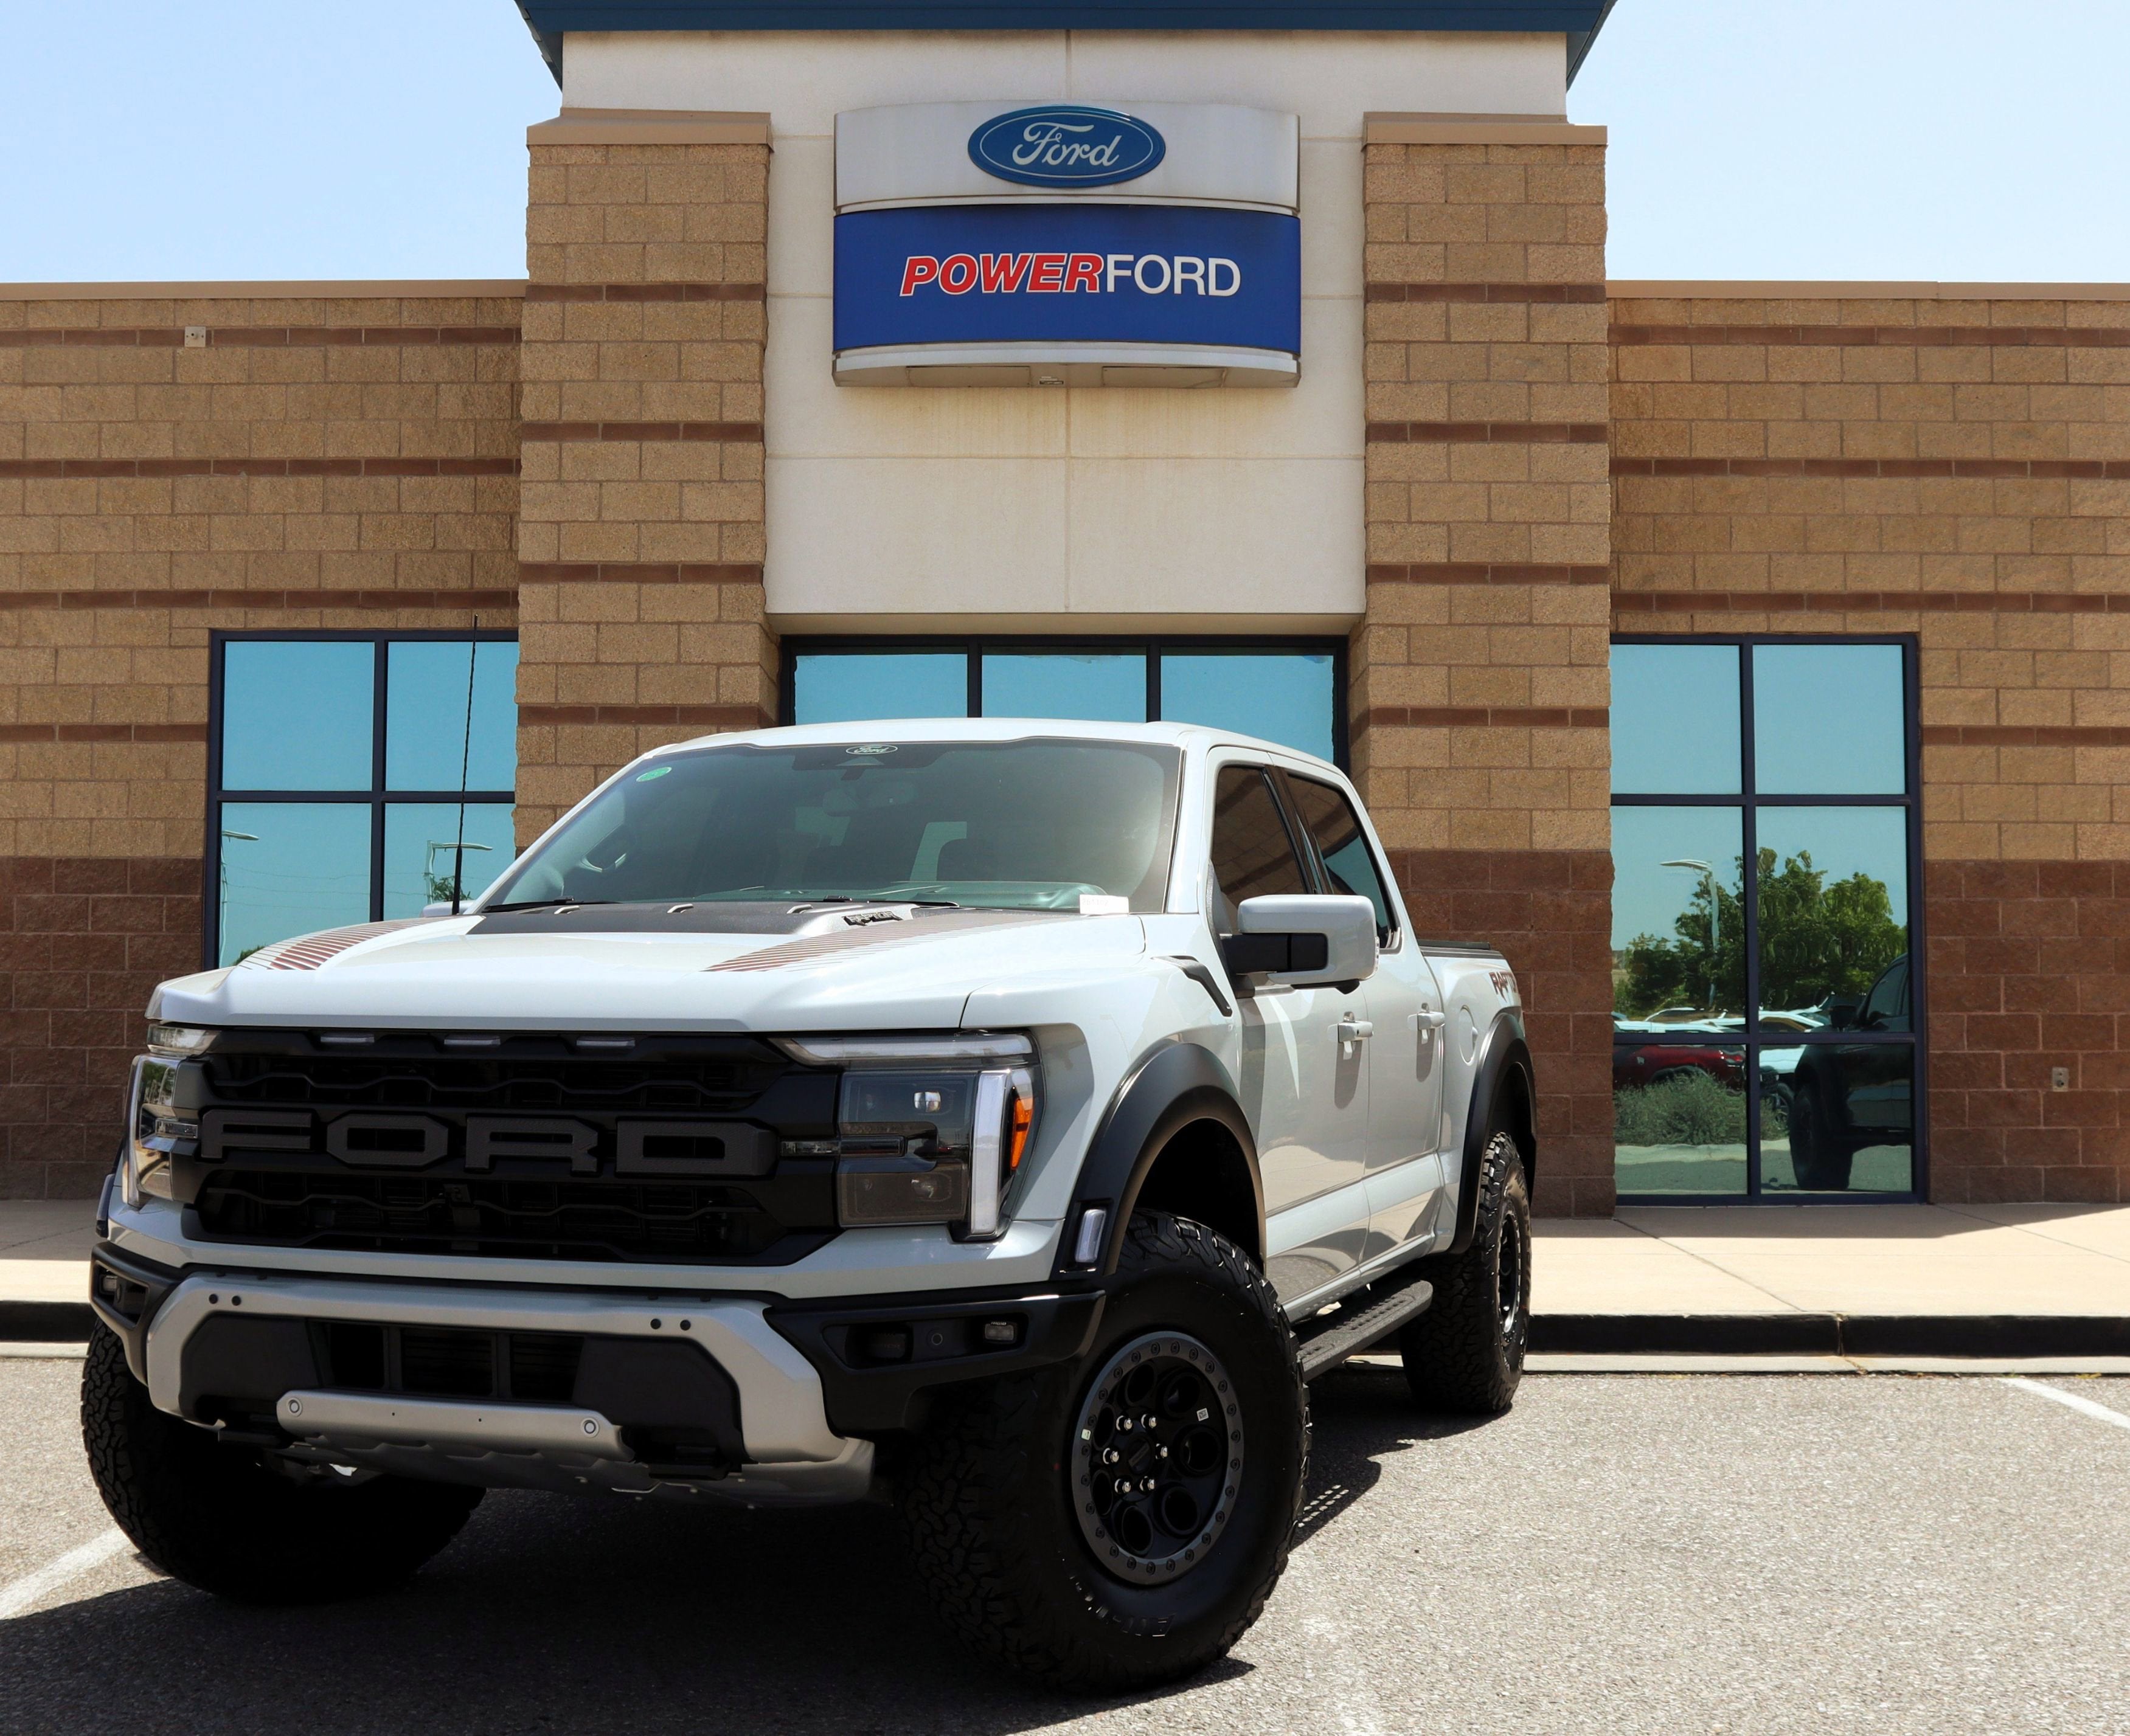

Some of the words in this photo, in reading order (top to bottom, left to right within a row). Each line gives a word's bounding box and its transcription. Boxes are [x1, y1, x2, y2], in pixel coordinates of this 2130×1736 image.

[1012, 122, 1123, 167] Ford
[854, 745, 890, 753] Ford
[844, 911, 903, 926] RAPTOR
[201, 1109, 777, 1176] FORD
